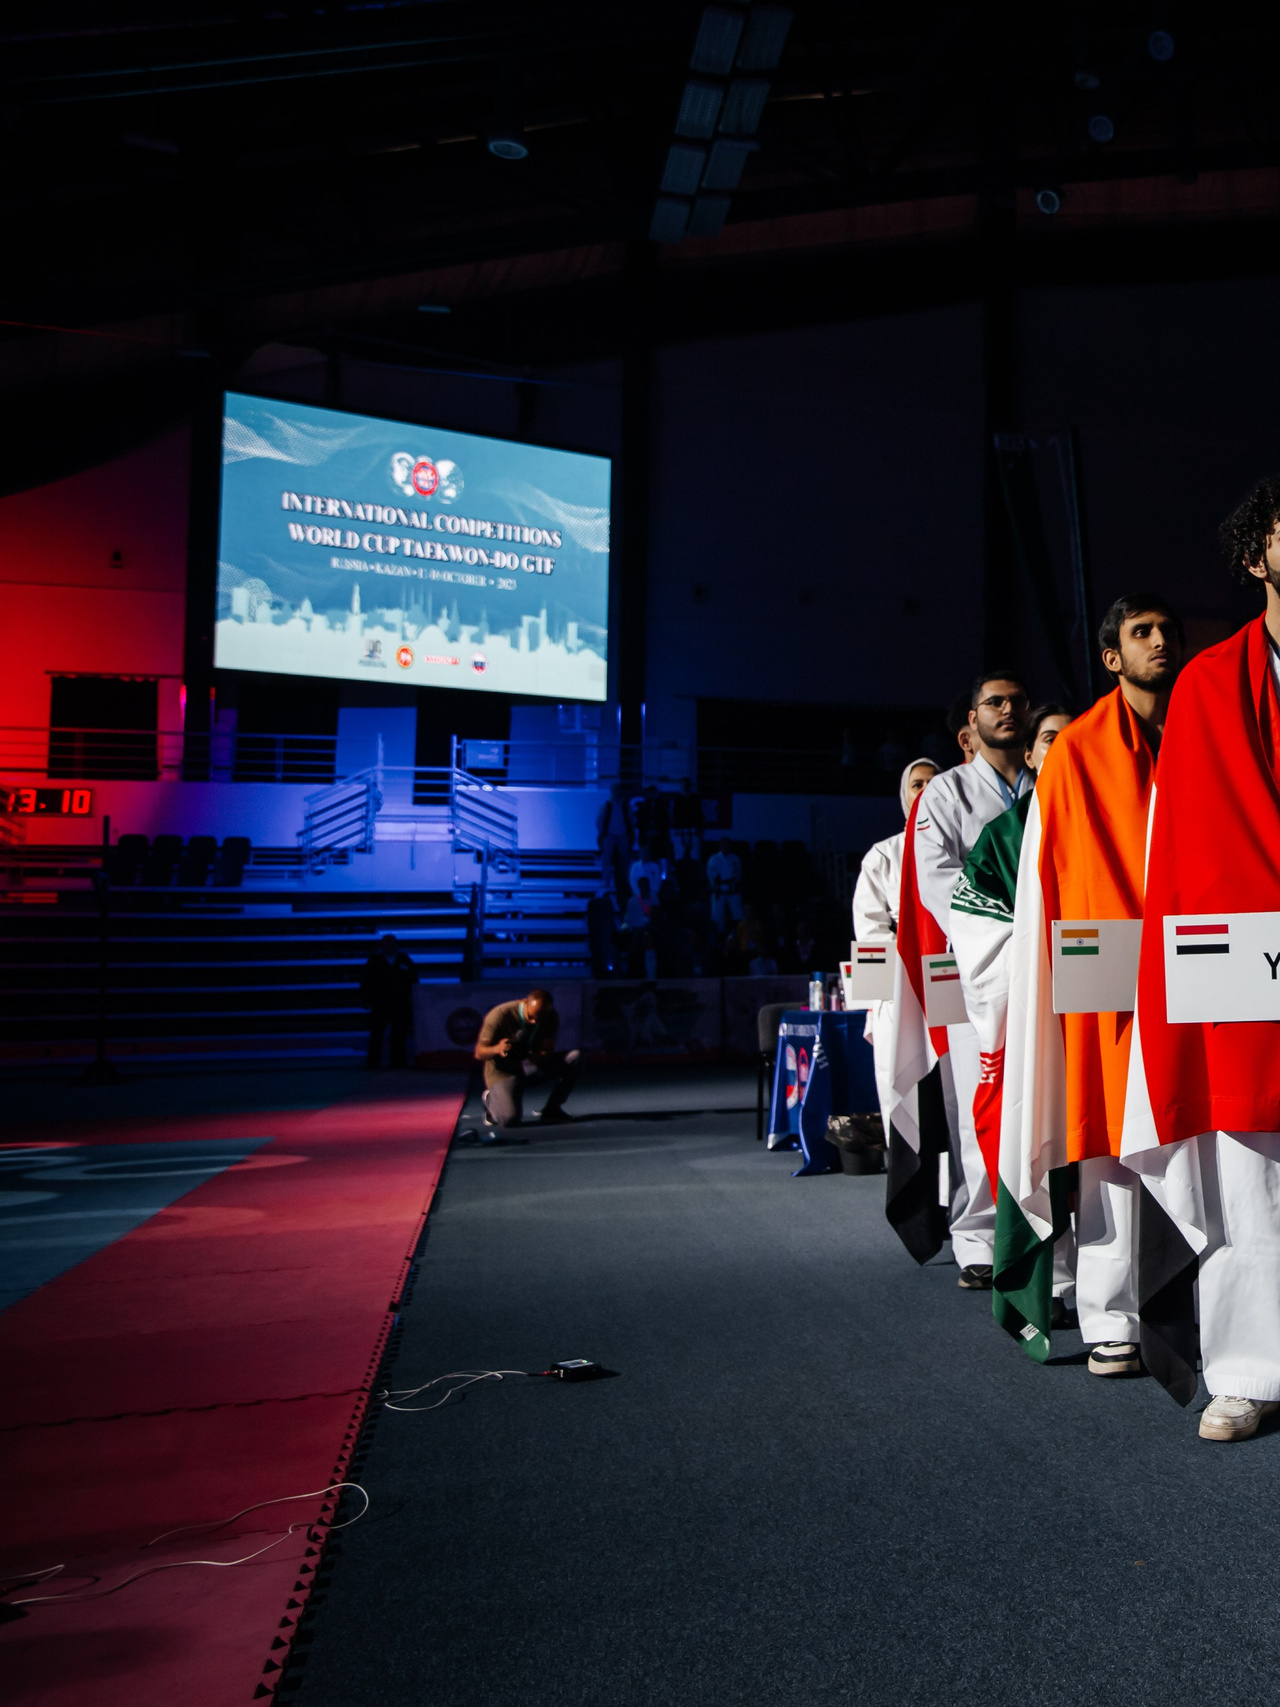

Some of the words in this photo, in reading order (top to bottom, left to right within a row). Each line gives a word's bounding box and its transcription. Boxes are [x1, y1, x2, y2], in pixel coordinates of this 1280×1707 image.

[282, 491, 433, 531] INTERNATIONAL
[433, 513, 562, 549] COMPETITIONS
[288, 522, 360, 550] WORLD
[362, 532, 401, 555] CUP
[401, 537, 520, 571] TAEKWON-DO
[520, 554, 556, 576] GTF
